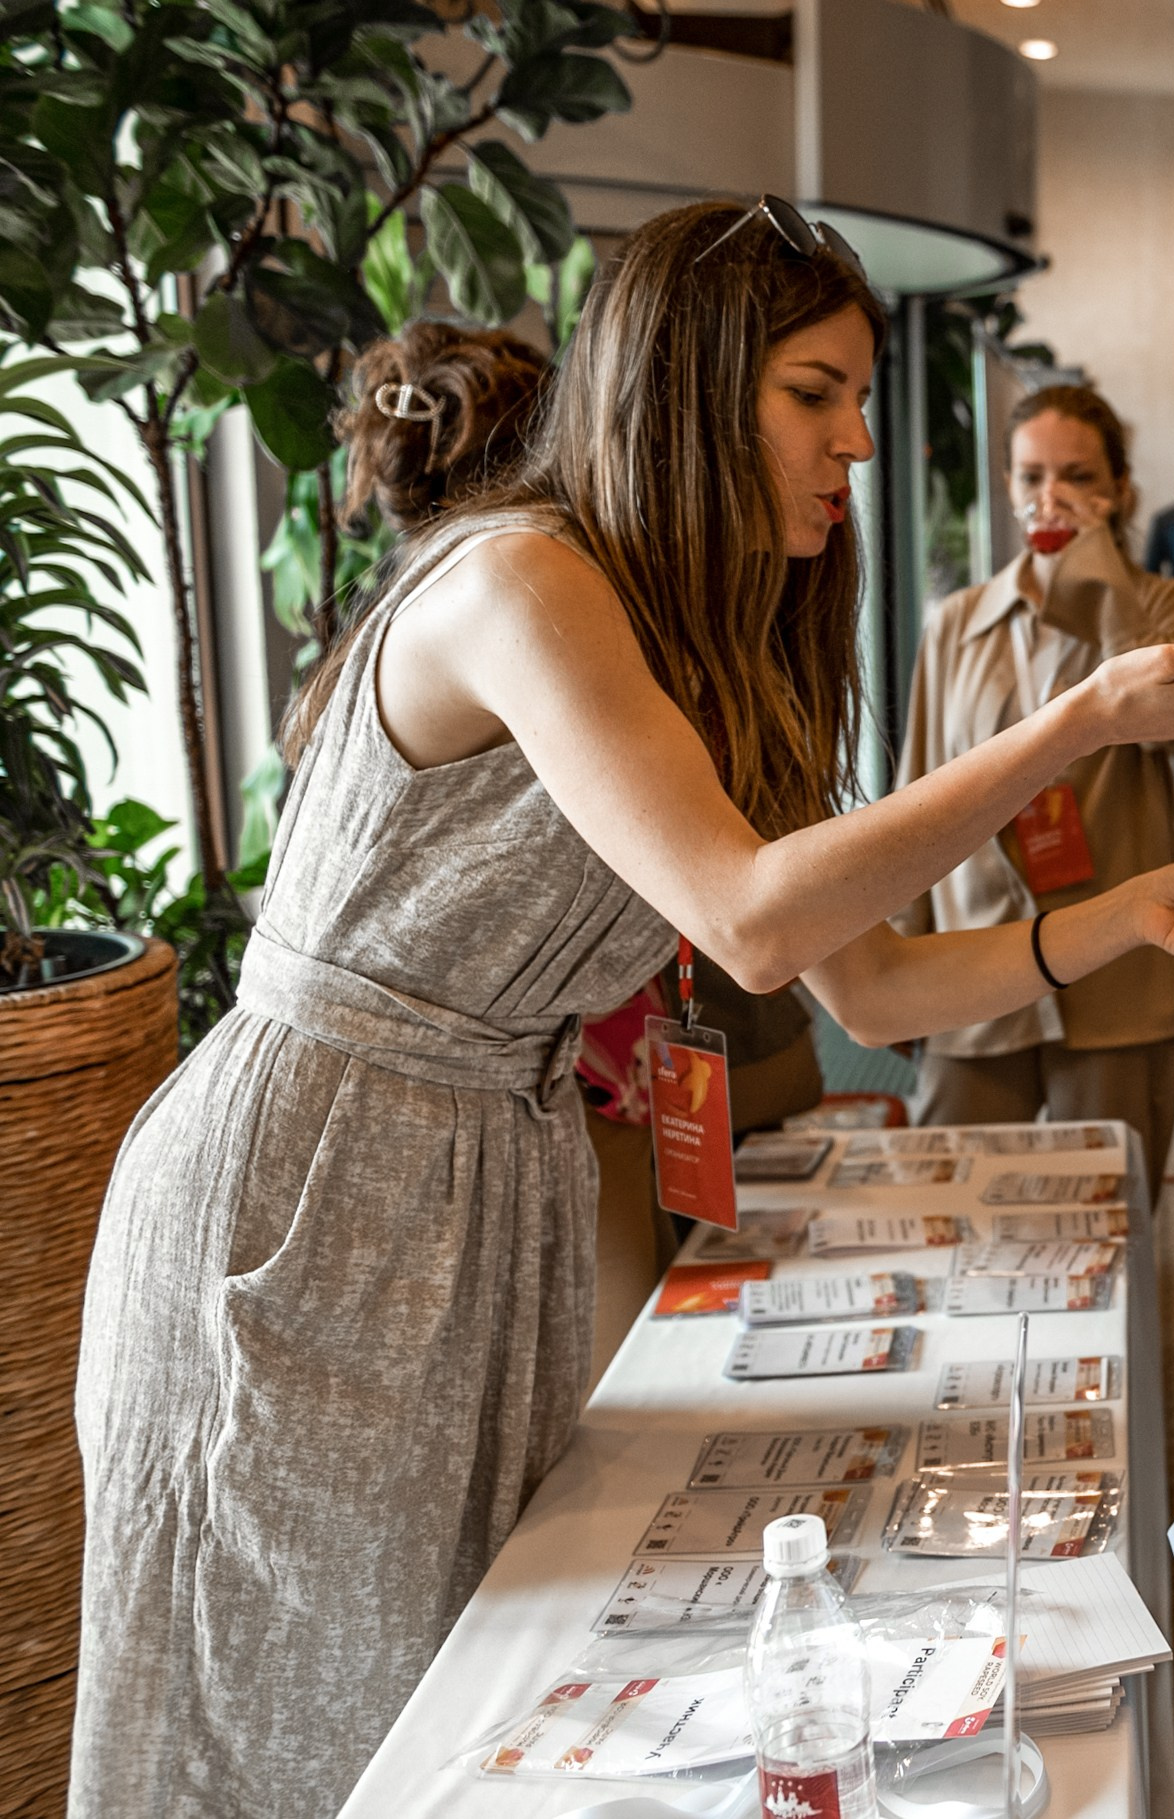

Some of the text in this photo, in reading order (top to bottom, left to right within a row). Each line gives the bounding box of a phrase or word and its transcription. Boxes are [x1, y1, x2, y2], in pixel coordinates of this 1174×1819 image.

[661, 1114, 704, 1134] ЕКАТЕРИНА
[662, 1128, 701, 1146] НЕРЕТИНА
[971, 1662, 994, 1696] RAPESEED
[985, 1660, 1004, 1687] WORLD
[645, 1697, 705, 1759] Участник
